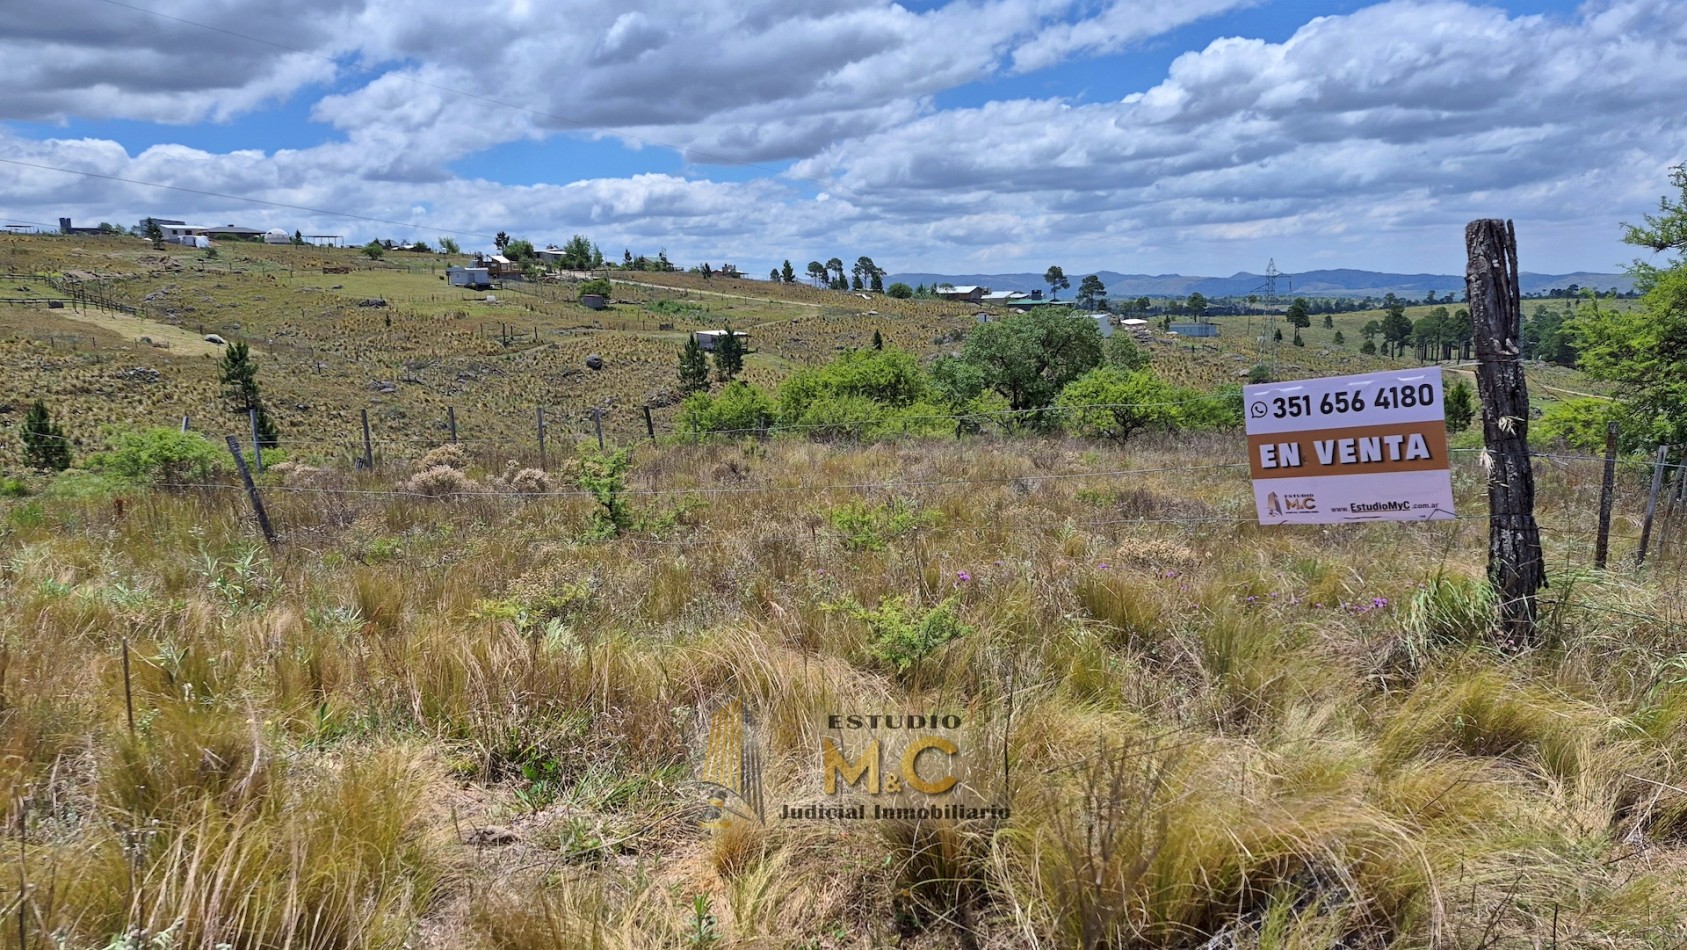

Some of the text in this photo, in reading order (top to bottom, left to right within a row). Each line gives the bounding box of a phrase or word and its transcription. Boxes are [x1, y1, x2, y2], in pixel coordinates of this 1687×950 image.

[1273, 384, 1434, 418] 351 656 4180
[1259, 433, 1431, 469] EN VENTA
[1350, 501, 1410, 513] EstudioMyC
